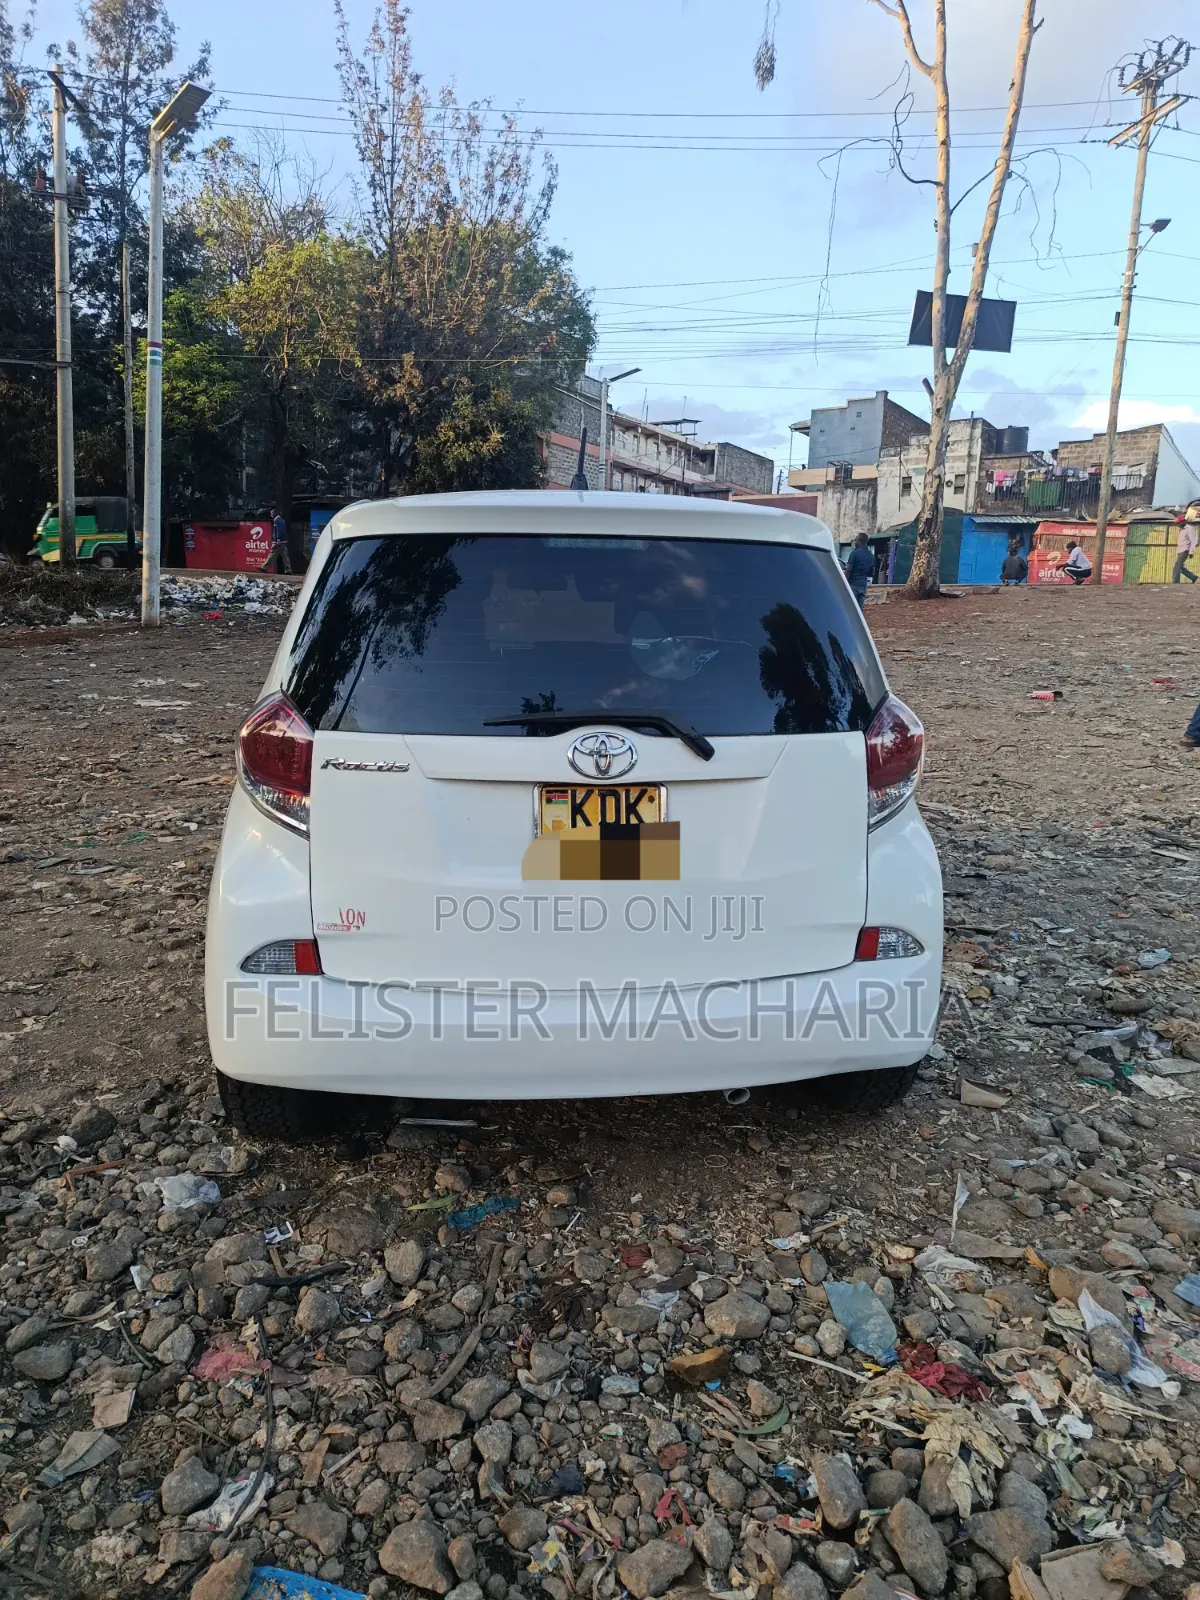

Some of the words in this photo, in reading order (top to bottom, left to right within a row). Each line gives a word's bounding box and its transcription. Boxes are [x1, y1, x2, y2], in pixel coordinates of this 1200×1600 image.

[245, 540, 269, 549] airtel
[1038, 567, 1066, 578] airtel
[320, 757, 410, 773] Ractis
[570, 788, 649, 829] KDK
